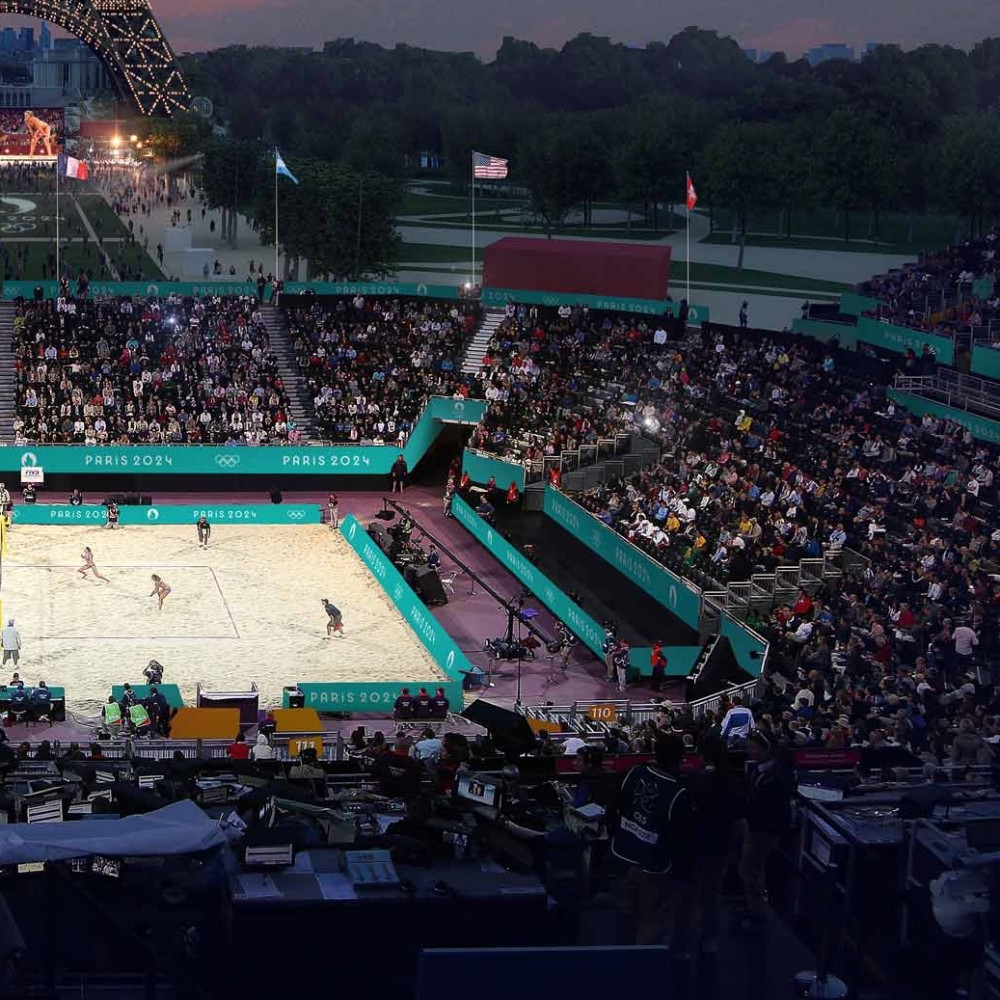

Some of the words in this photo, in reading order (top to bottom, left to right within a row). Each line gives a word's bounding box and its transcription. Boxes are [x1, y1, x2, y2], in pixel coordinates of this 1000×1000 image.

[193, 286, 224, 294] PARIS
[336, 286, 368, 294] PARIS
[370, 286, 400, 294] 2024
[85, 455, 128, 466] PARIS
[133, 455, 172, 466] 2024
[282, 455, 326, 466] PARIS
[330, 455, 370, 466] 2024
[50, 510, 82, 519] PARIS
[193, 510, 225, 519] PARIS
[228, 510, 257, 519] 2024
[310, 692, 354, 703] PARIS
[592, 708, 611, 718] 110
